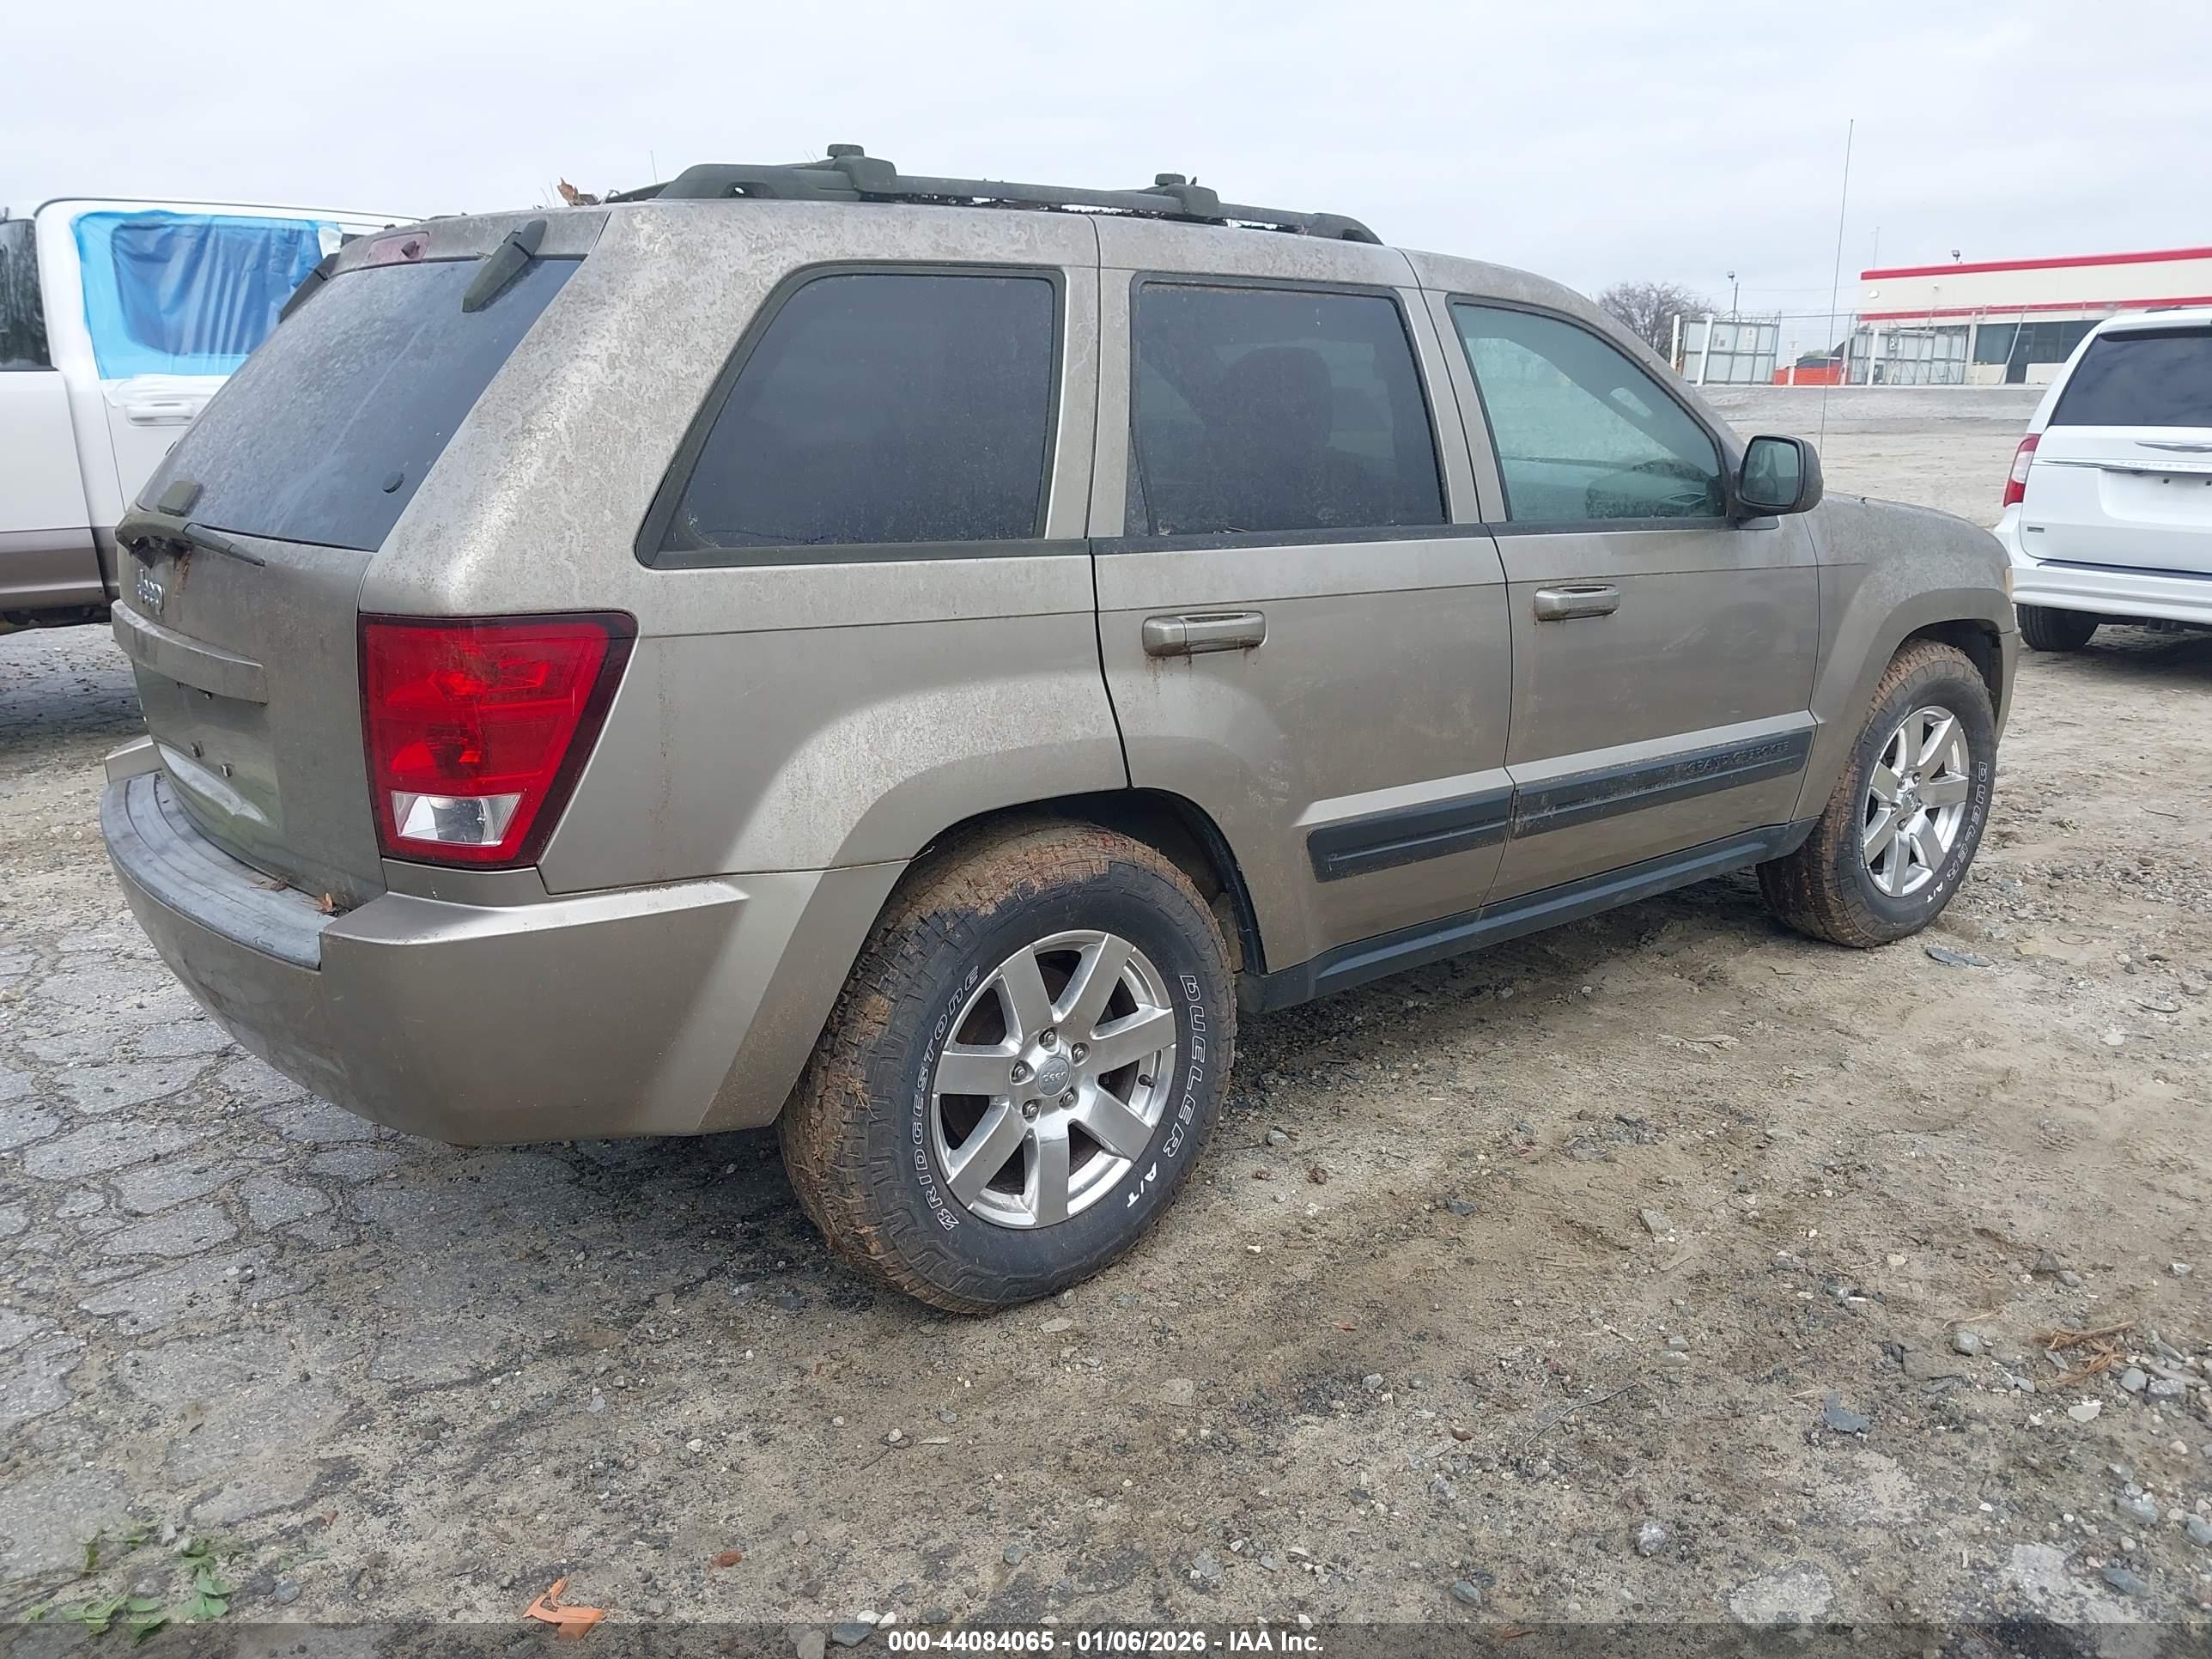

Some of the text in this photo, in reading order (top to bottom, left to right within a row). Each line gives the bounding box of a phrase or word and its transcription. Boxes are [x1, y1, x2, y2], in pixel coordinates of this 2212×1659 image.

[1926, 761, 1988, 903] DUELER A/T
[912, 965, 980, 1231] BRIDGESTONE
[1127, 975, 1206, 1208] DUELER A/T
